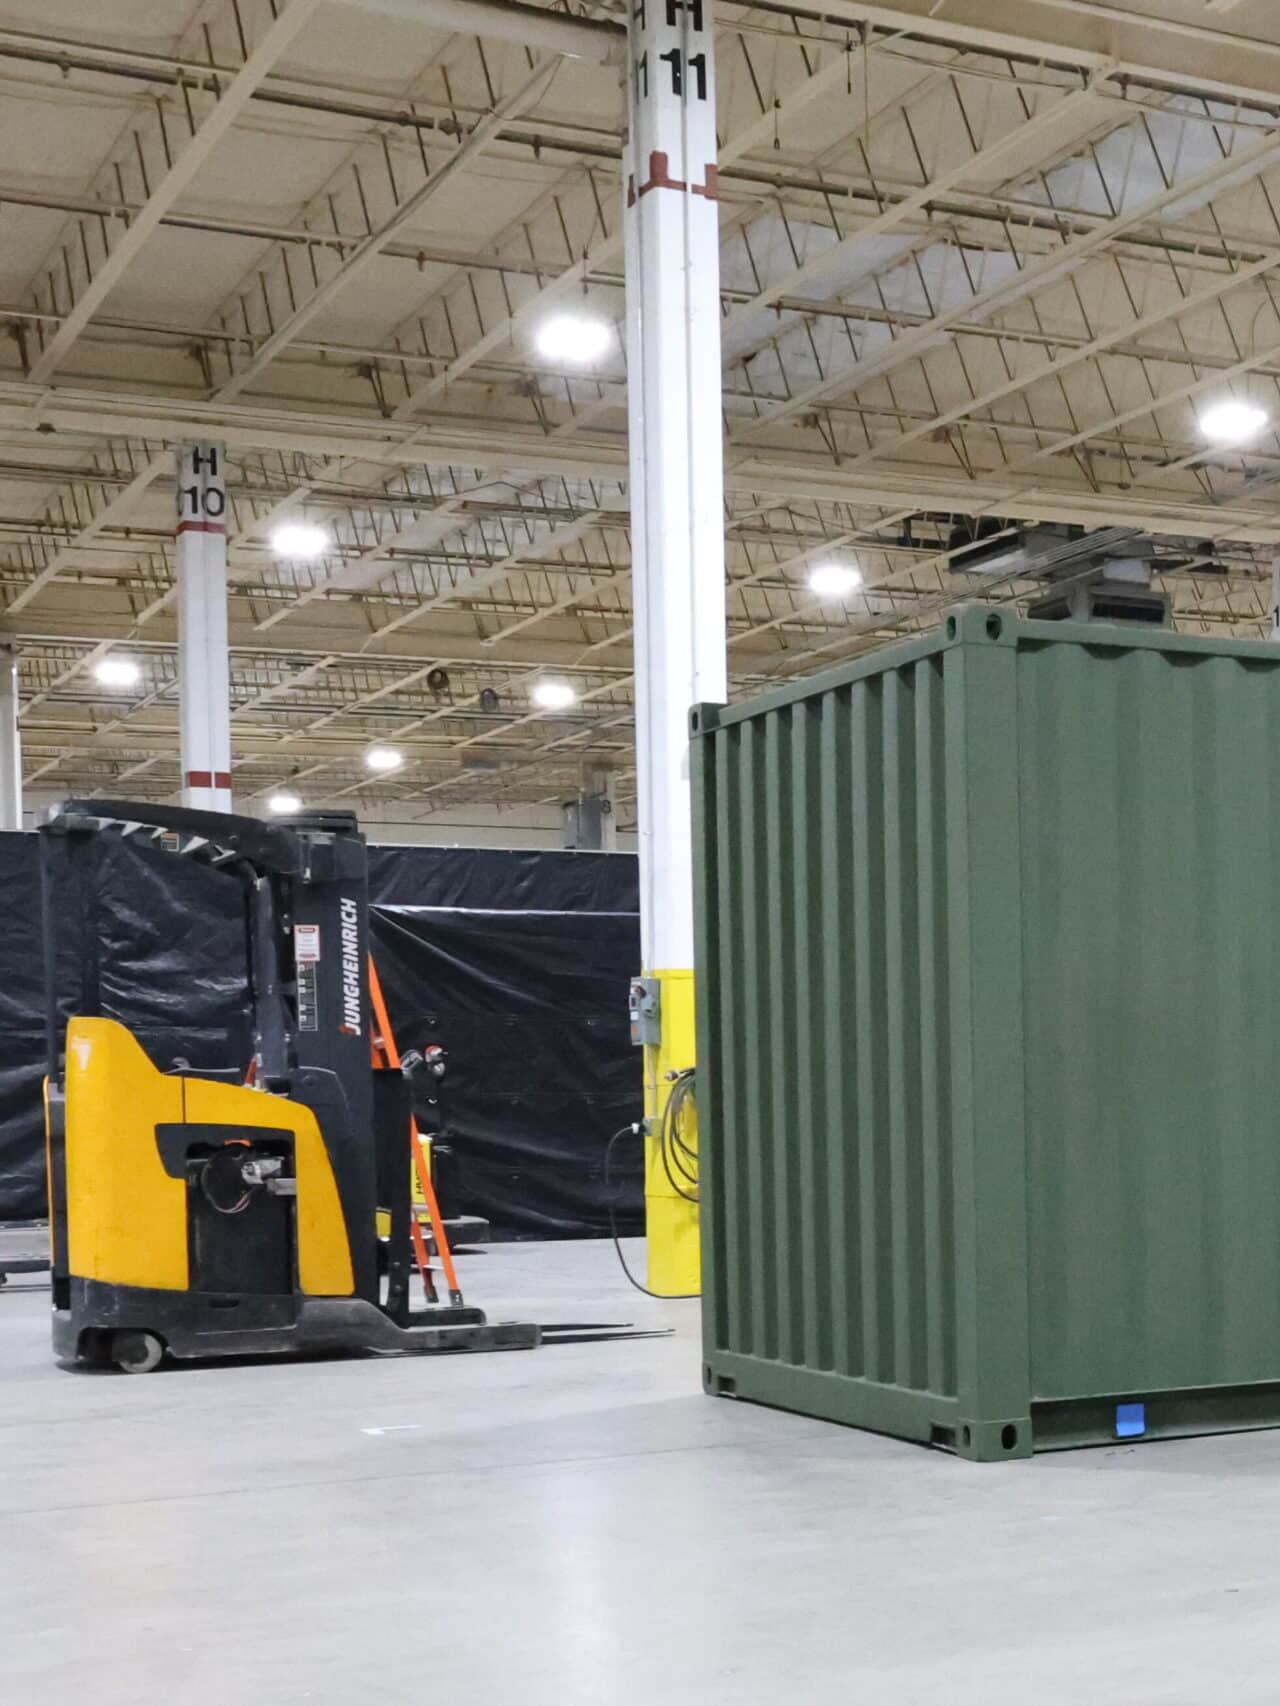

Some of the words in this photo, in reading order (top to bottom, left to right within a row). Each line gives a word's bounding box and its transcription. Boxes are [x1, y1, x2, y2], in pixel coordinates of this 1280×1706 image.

[665, 0, 703, 32] H
[659, 48, 707, 101] 11
[192, 446, 218, 476] H
[183, 486, 225, 517] 10
[339, 898, 361, 1036] JUNGHEINRICH
